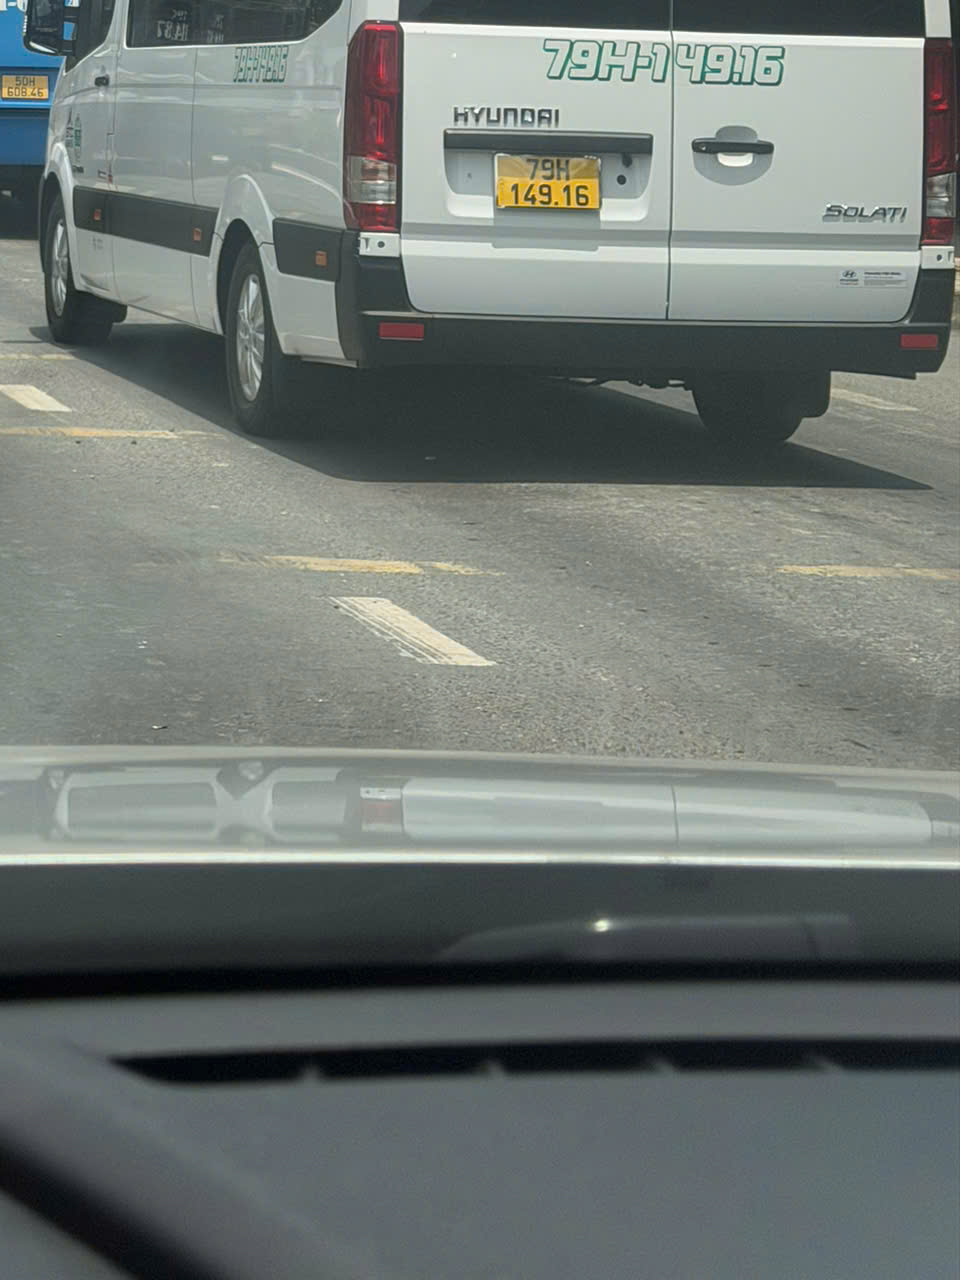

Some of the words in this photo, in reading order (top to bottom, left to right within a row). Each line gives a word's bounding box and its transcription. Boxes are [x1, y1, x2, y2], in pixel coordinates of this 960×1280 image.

[15, 76, 36, 87] 50H
[453, 106, 560, 128] HYUNDAI
[526, 158, 571, 182] 79H
[511, 183, 590, 207] 149.16
[823, 204, 907, 223] SOLATI
